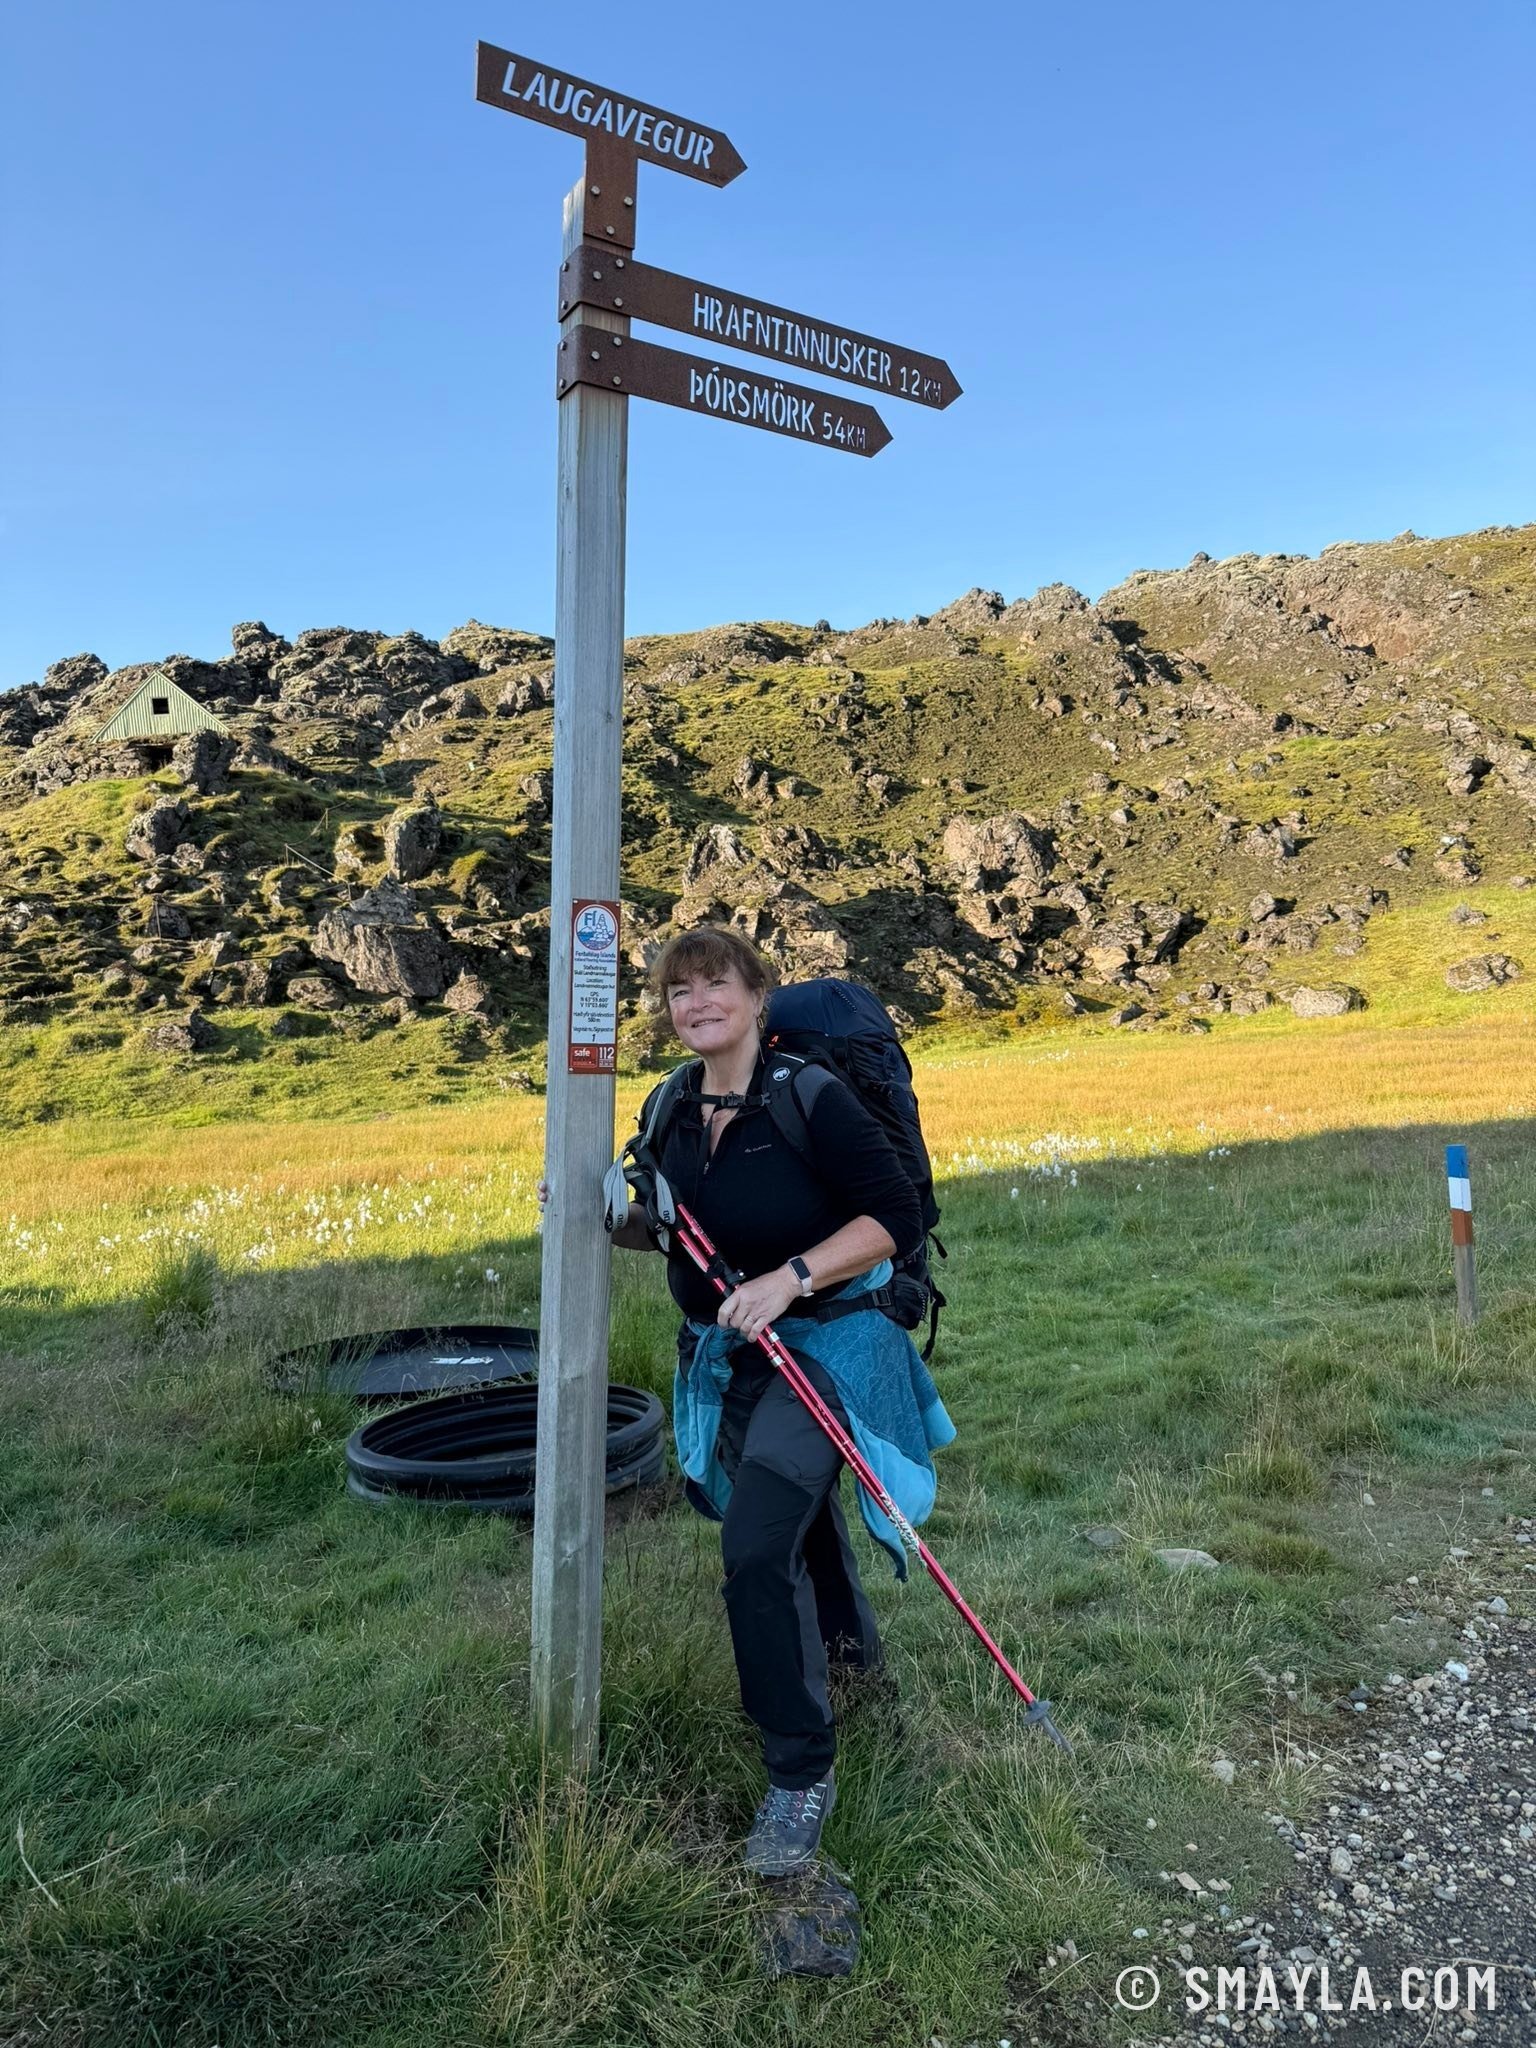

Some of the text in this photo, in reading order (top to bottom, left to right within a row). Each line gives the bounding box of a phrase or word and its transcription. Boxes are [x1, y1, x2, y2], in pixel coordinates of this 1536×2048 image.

[502, 61, 715, 169] LAUGAVEGUR
[693, 292, 892, 386] HRAFNTINNUSKER
[690, 366, 815, 436] ÞÓRSMÖRK
[574, 1048, 590, 1056] safe
[592, 1034, 596, 1042] 1
[599, 1046, 615, 1059] 112
